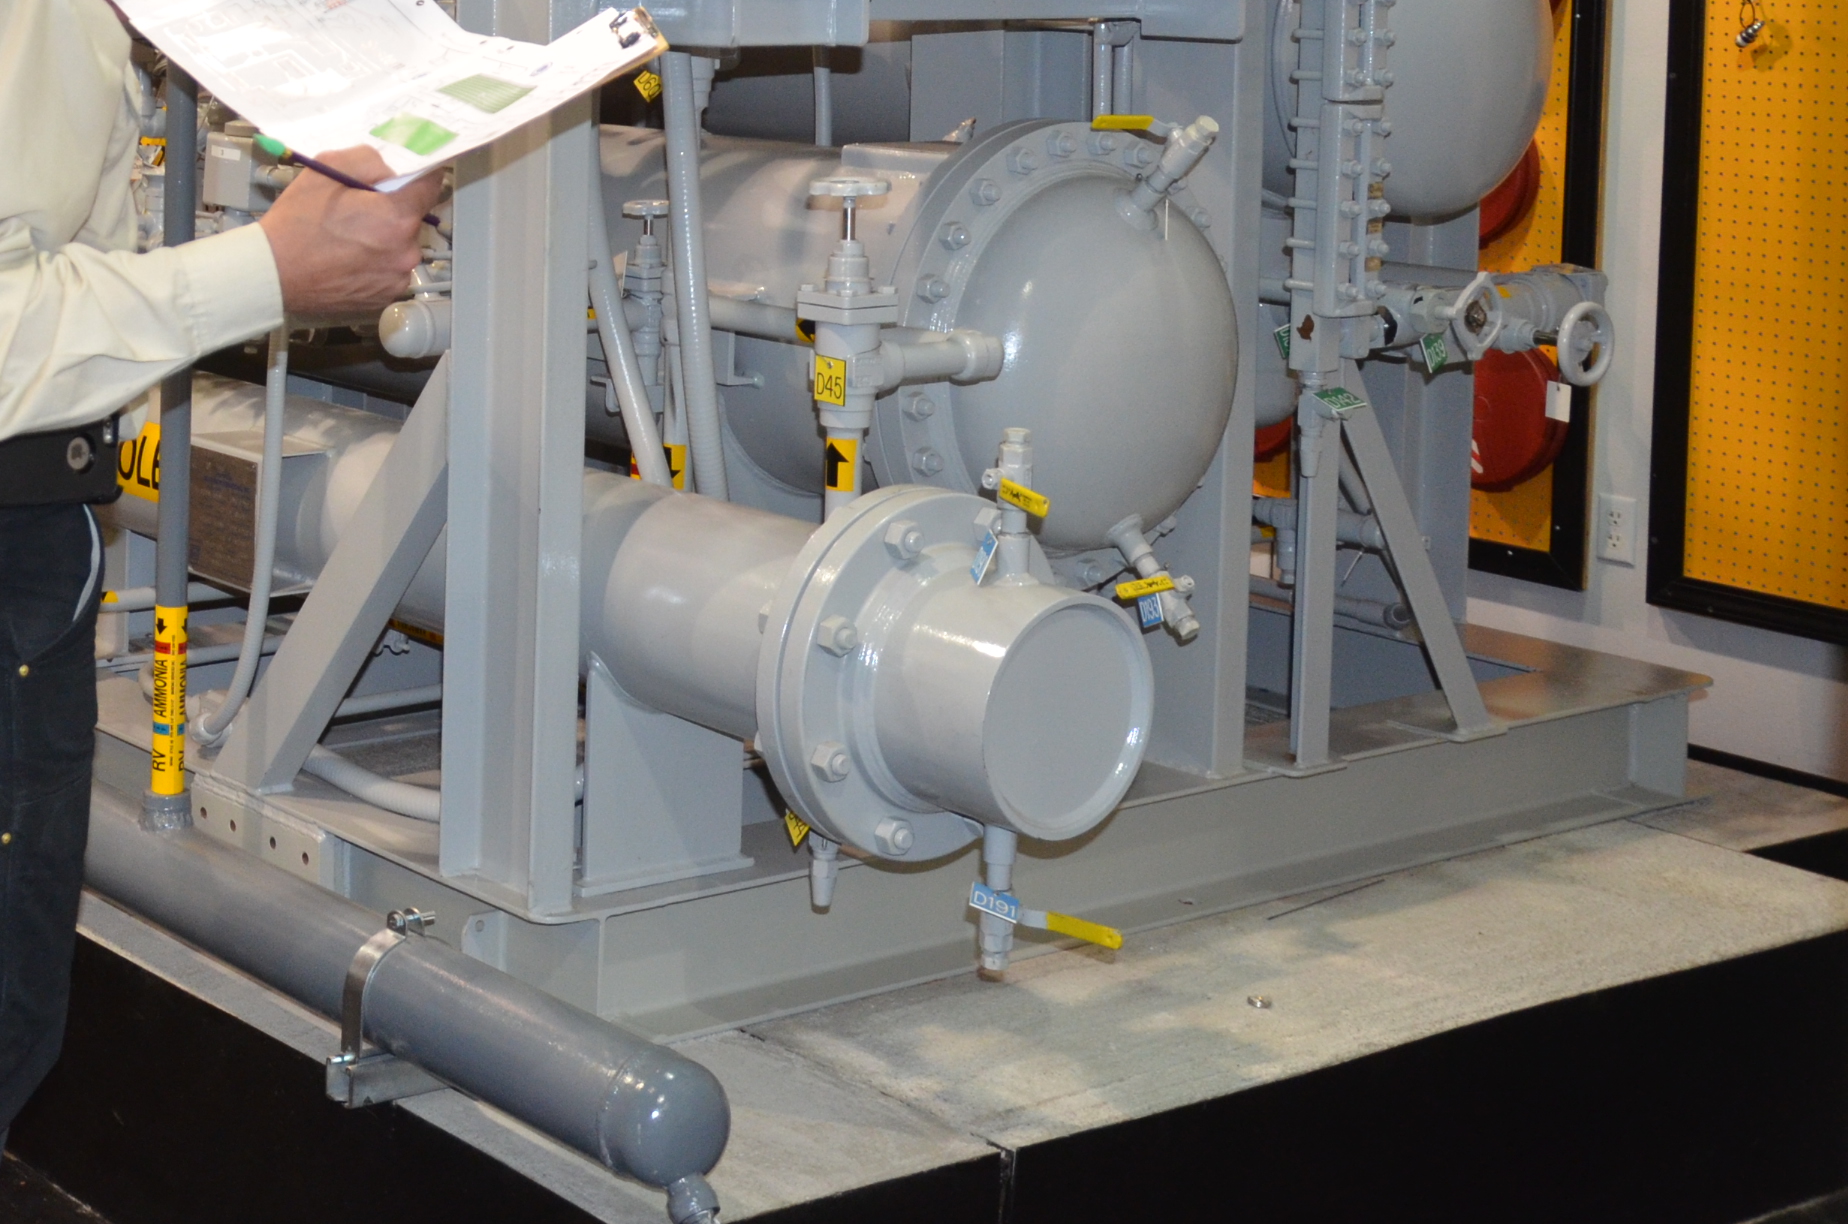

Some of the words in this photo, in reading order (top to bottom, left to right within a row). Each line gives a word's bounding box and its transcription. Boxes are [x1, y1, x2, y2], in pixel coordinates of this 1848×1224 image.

[816, 372, 843, 400] D45
[154, 659, 168, 718] AMMONIA
[152, 749, 166, 772] RV
[973, 890, 1016, 918] D191
